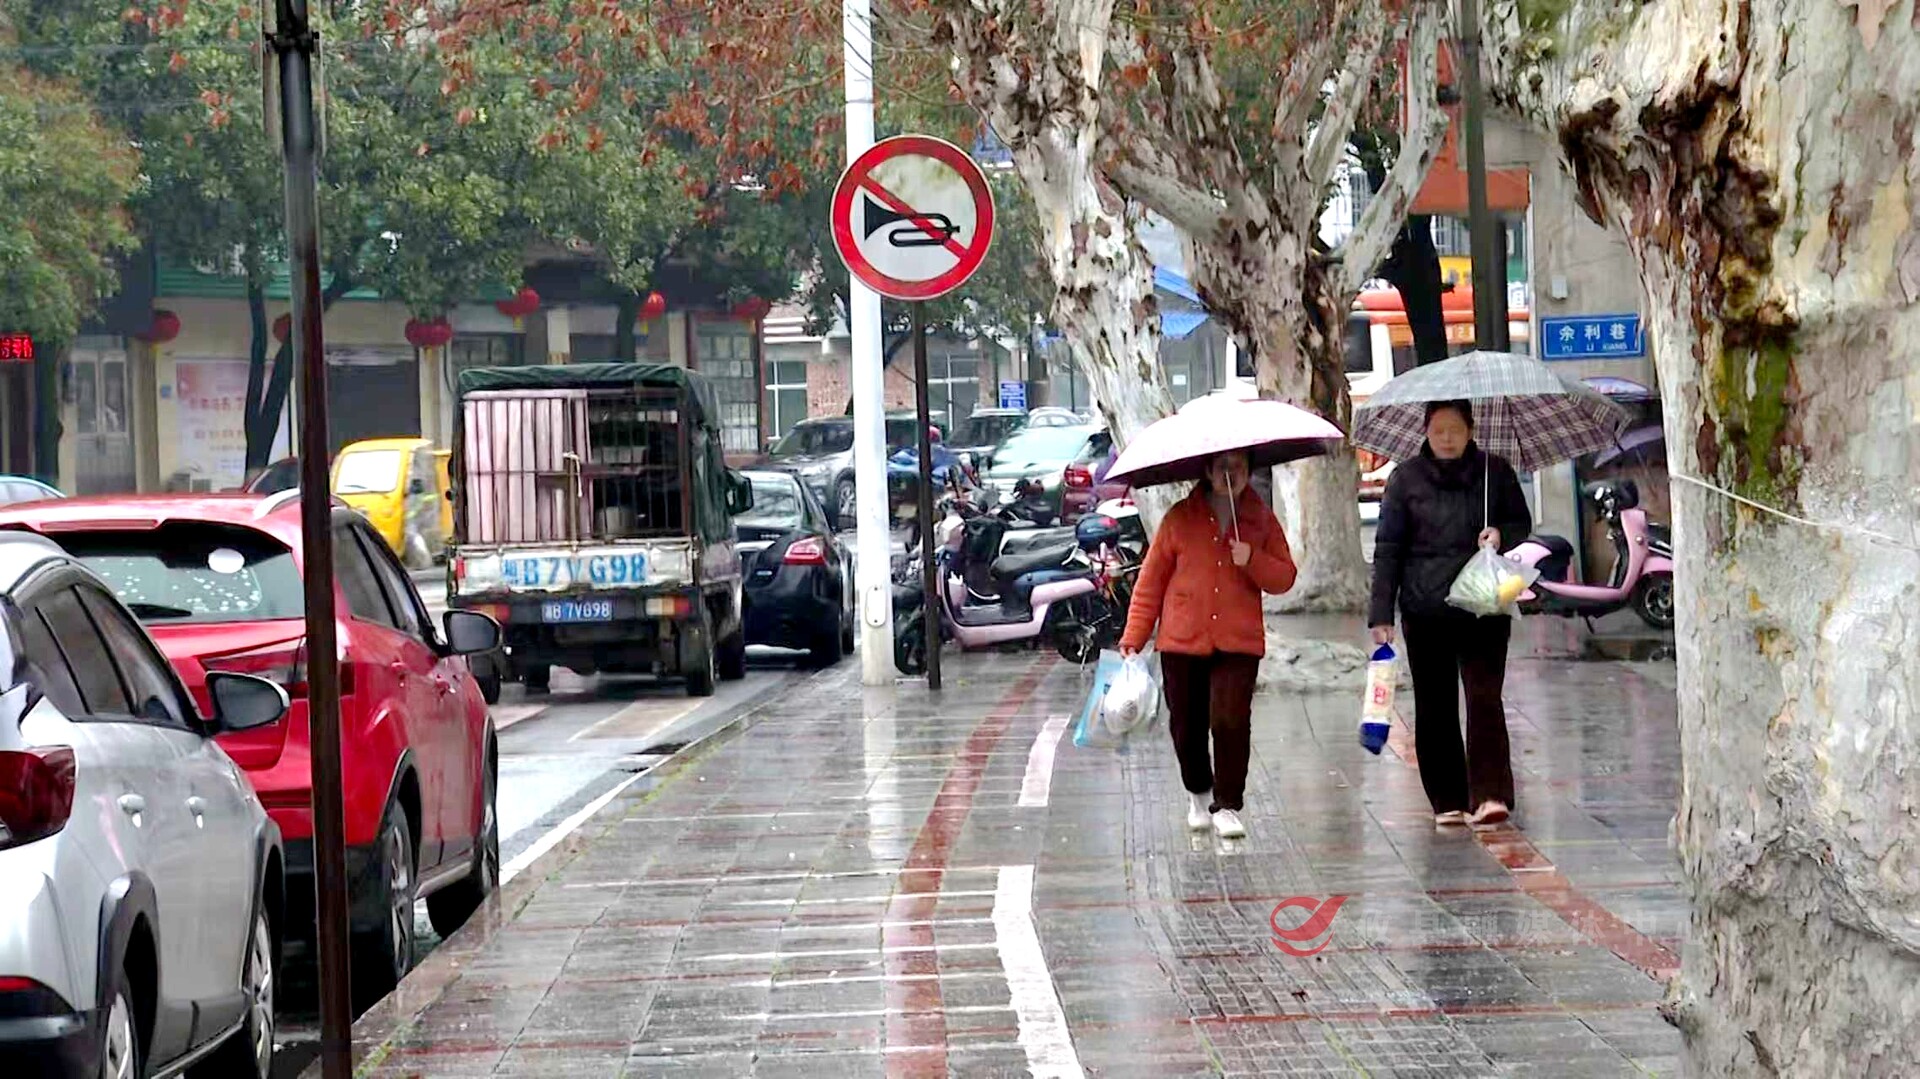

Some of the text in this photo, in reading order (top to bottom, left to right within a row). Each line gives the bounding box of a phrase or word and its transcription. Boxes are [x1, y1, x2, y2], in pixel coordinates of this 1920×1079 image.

[1559, 323, 1626, 341] 余利巷
[545, 601, 610, 620] B7VG98
